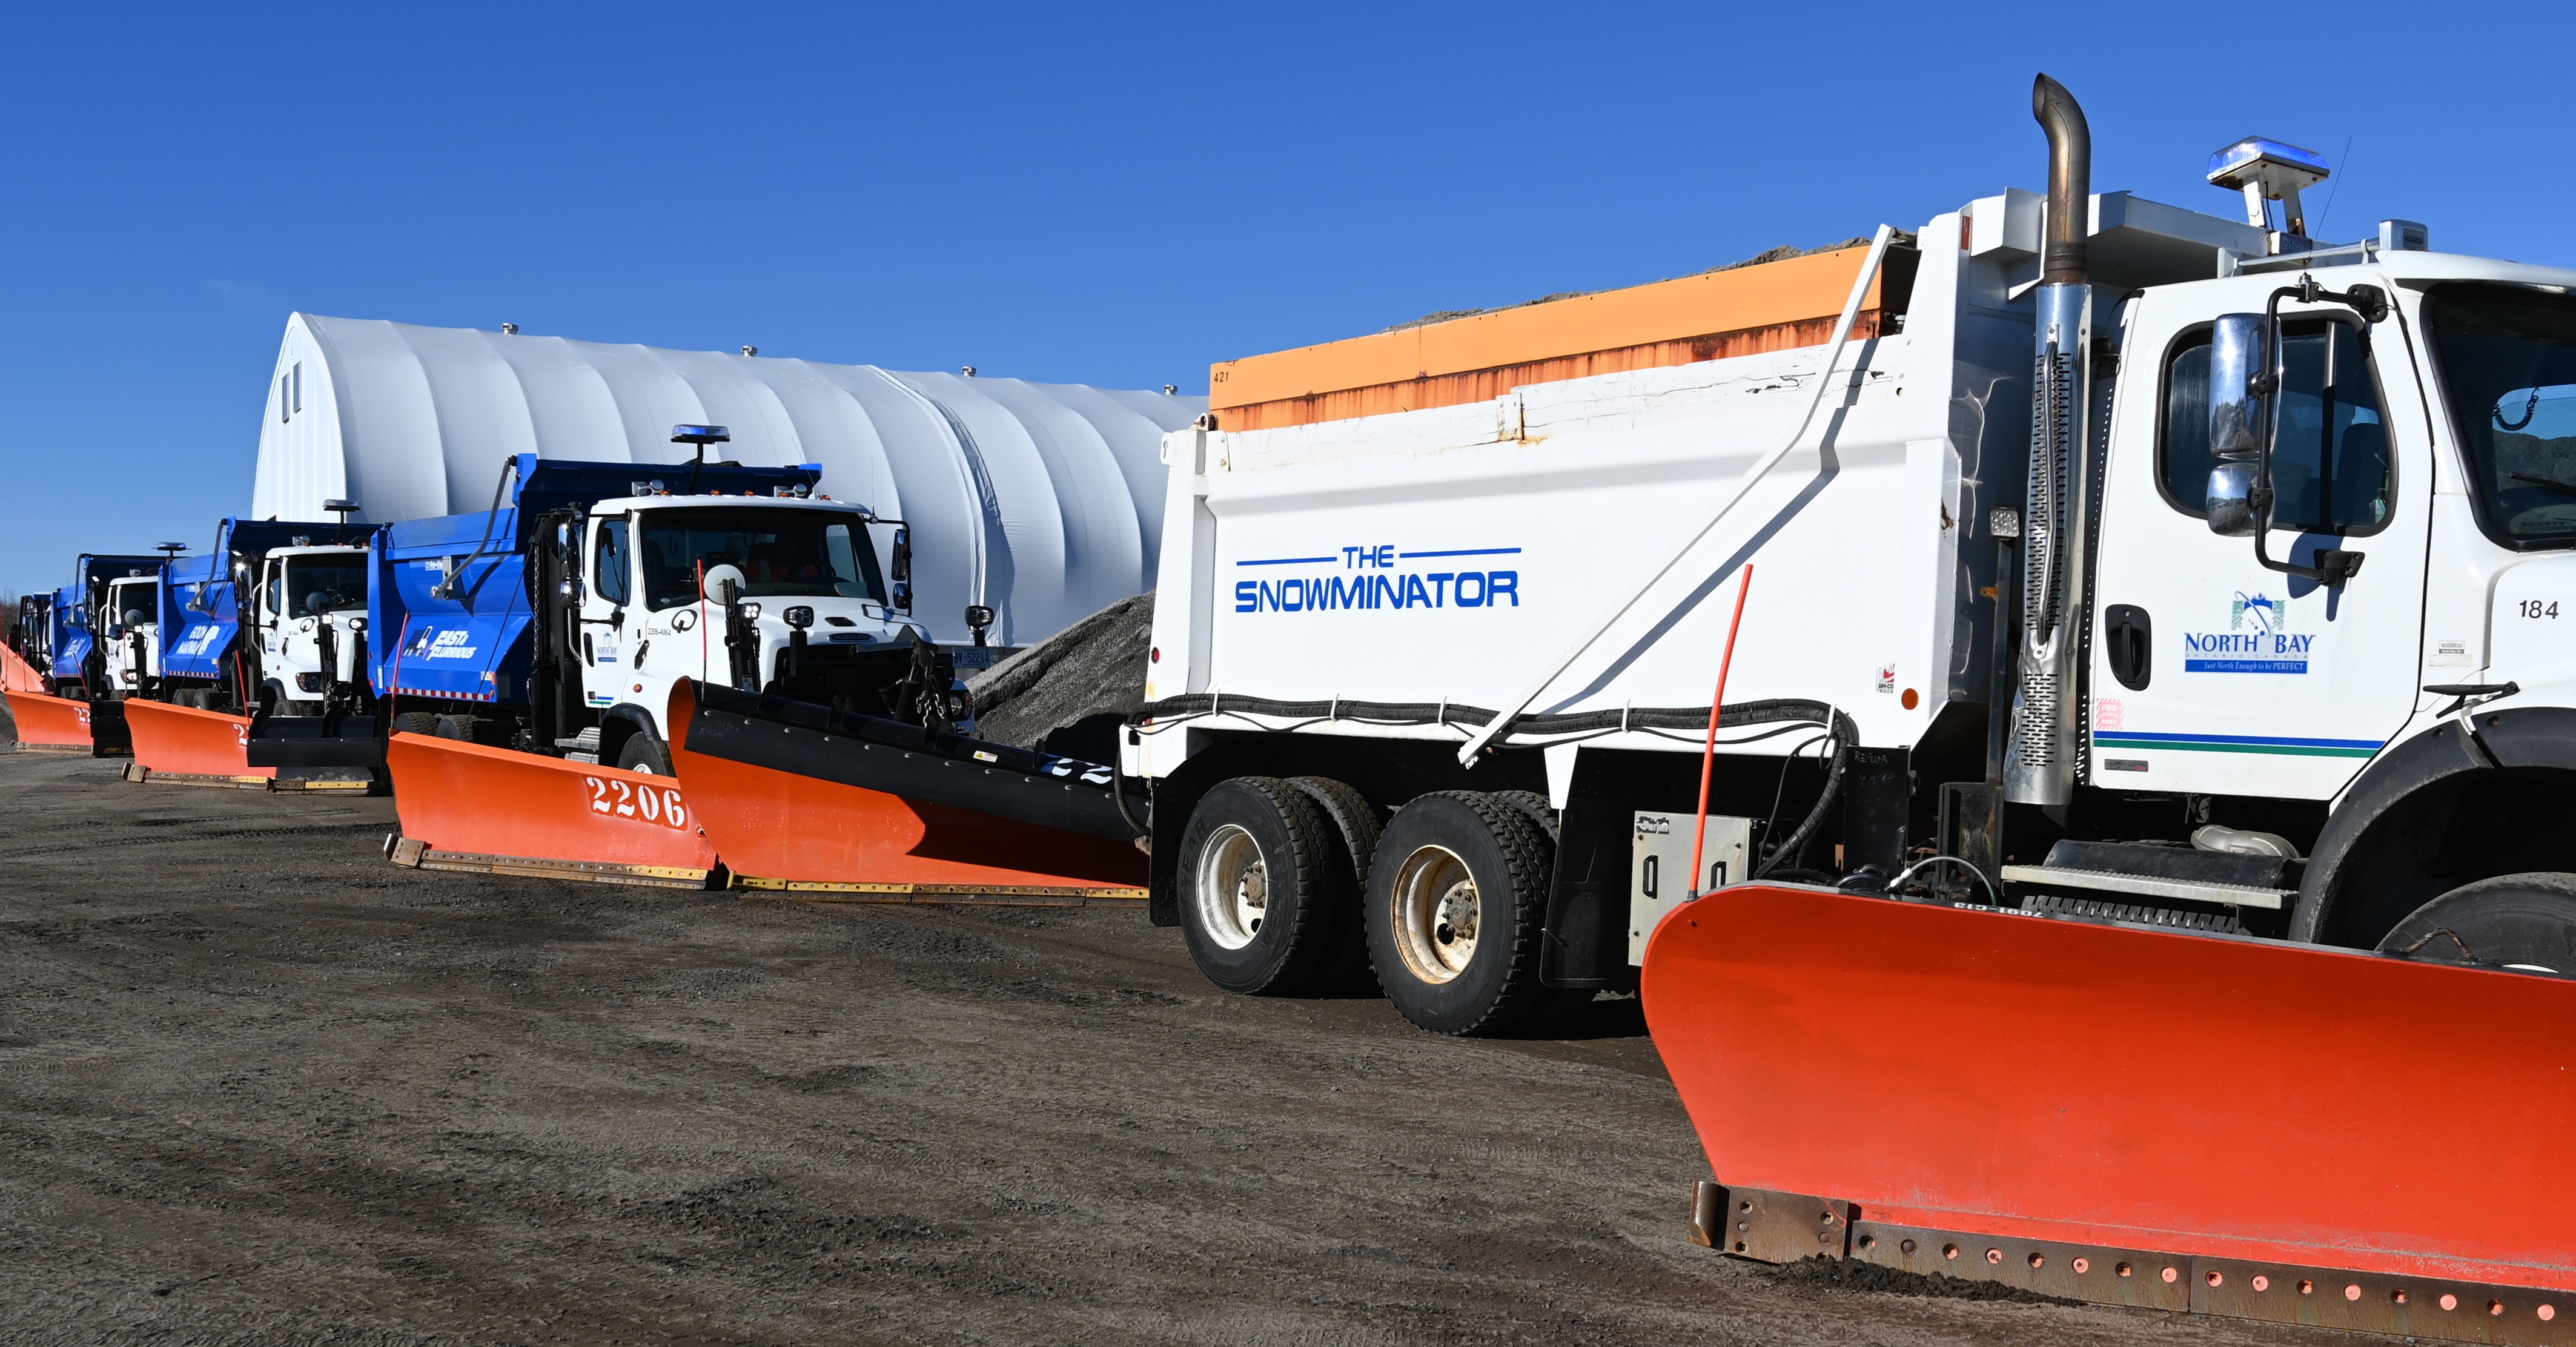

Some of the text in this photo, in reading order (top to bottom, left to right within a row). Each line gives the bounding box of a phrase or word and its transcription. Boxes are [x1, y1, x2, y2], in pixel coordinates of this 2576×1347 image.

[1214, 371, 1229, 383] 421
[1342, 544, 1394, 569] THE
[1236, 571, 1519, 613] SNOWMINATOR
[2519, 600, 2559, 620] 184
[2184, 632, 2316, 654] NORTH BAY
[2204, 661, 2216, 670] Just
[2235, 661, 2257, 672] Enough
[2273, 662, 2304, 670] PERFECT
[586, 776, 685, 827] 2206
[1953, 902, 2045, 918] 7091-C13
